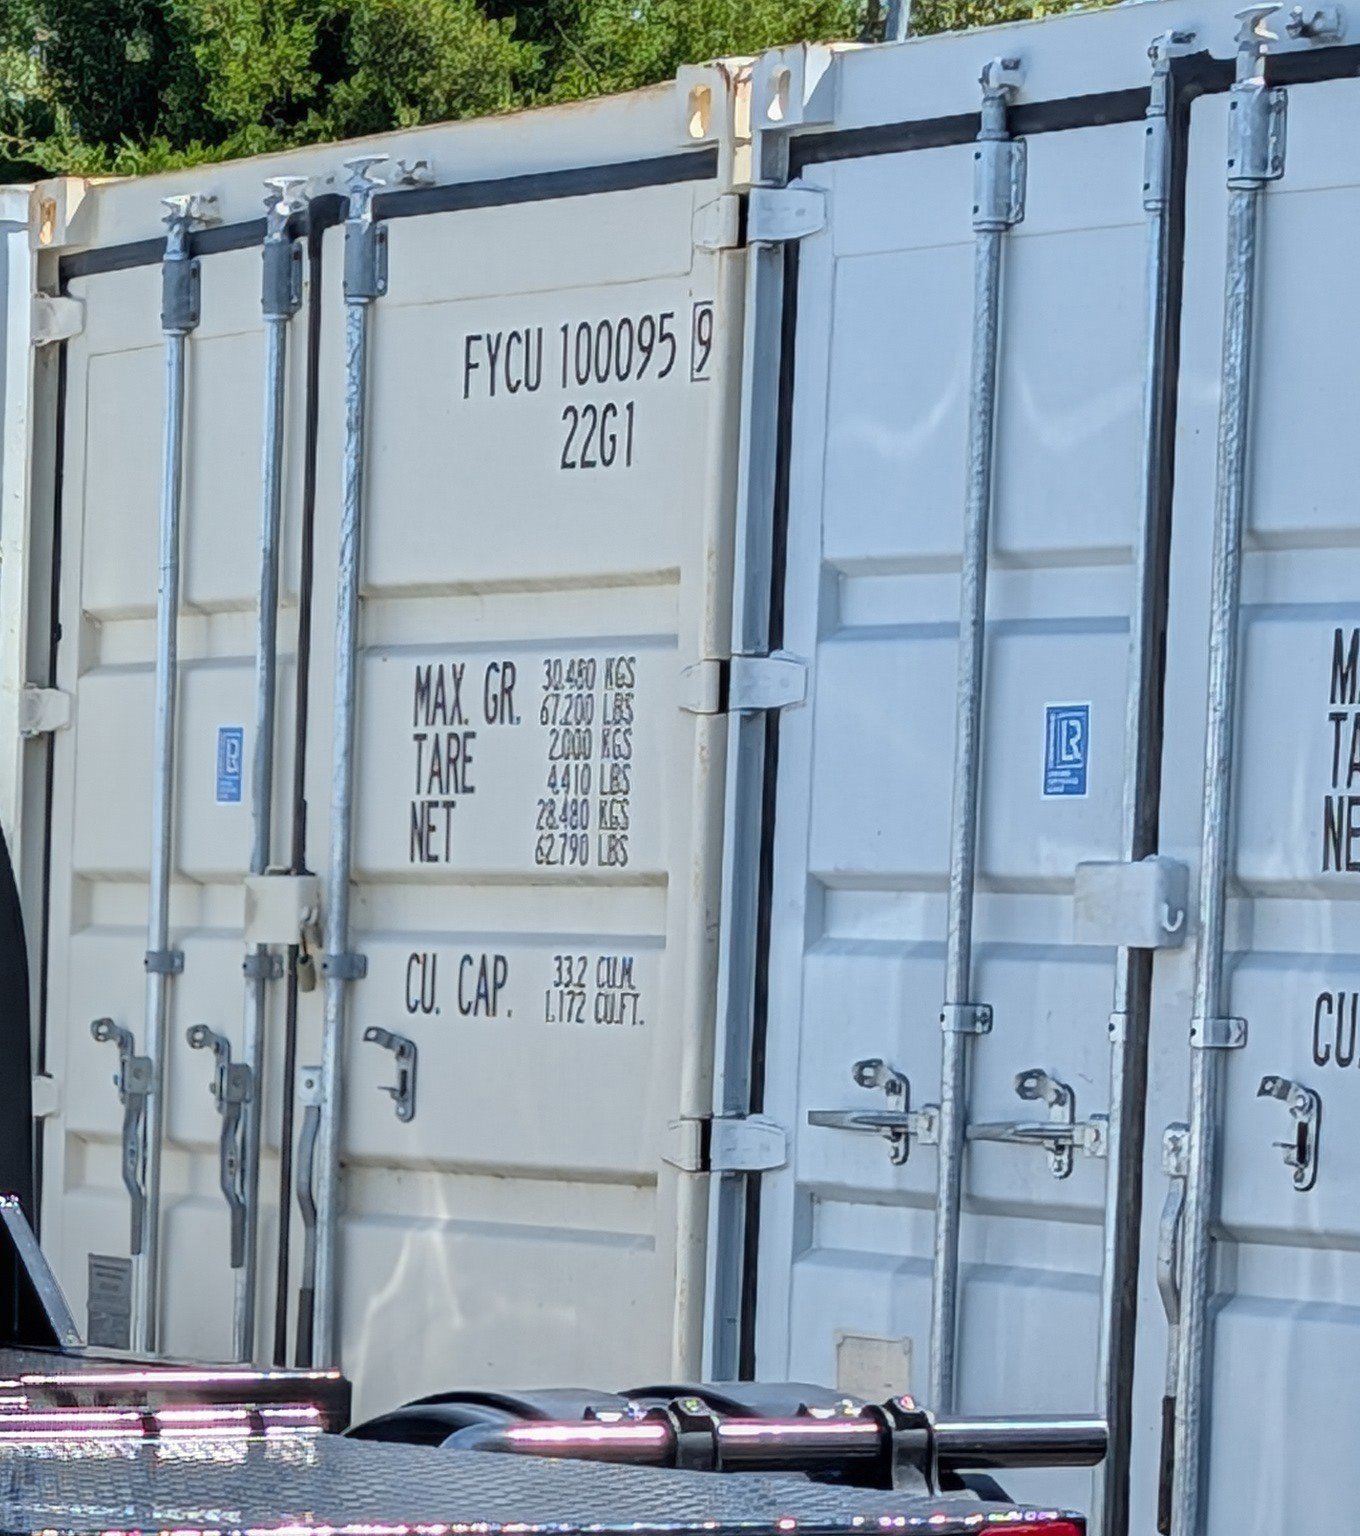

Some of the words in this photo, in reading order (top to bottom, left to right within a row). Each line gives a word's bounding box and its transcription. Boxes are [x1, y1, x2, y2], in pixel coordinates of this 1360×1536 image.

[463, 327, 543, 400] FYCU
[560, 311, 677, 389] 100095
[695, 307, 714, 374] 9
[560, 400, 635, 470] 22G1
[413, 662, 469, 728] MAX.
[483, 660, 522, 726] GR.
[604, 655, 636, 691] KGS
[1329, 627, 1360, 705] M
[602, 691, 635, 726] LBS
[412, 730, 478, 796] TARE
[600, 727, 634, 761] KGS
[598, 762, 632, 796] LBS
[409, 800, 457, 864] NET
[598, 797, 630, 831] KGS
[597, 832, 629, 868] LBS
[406, 952, 441, 1015] CU.
[458, 952, 513, 1018] CAP.
